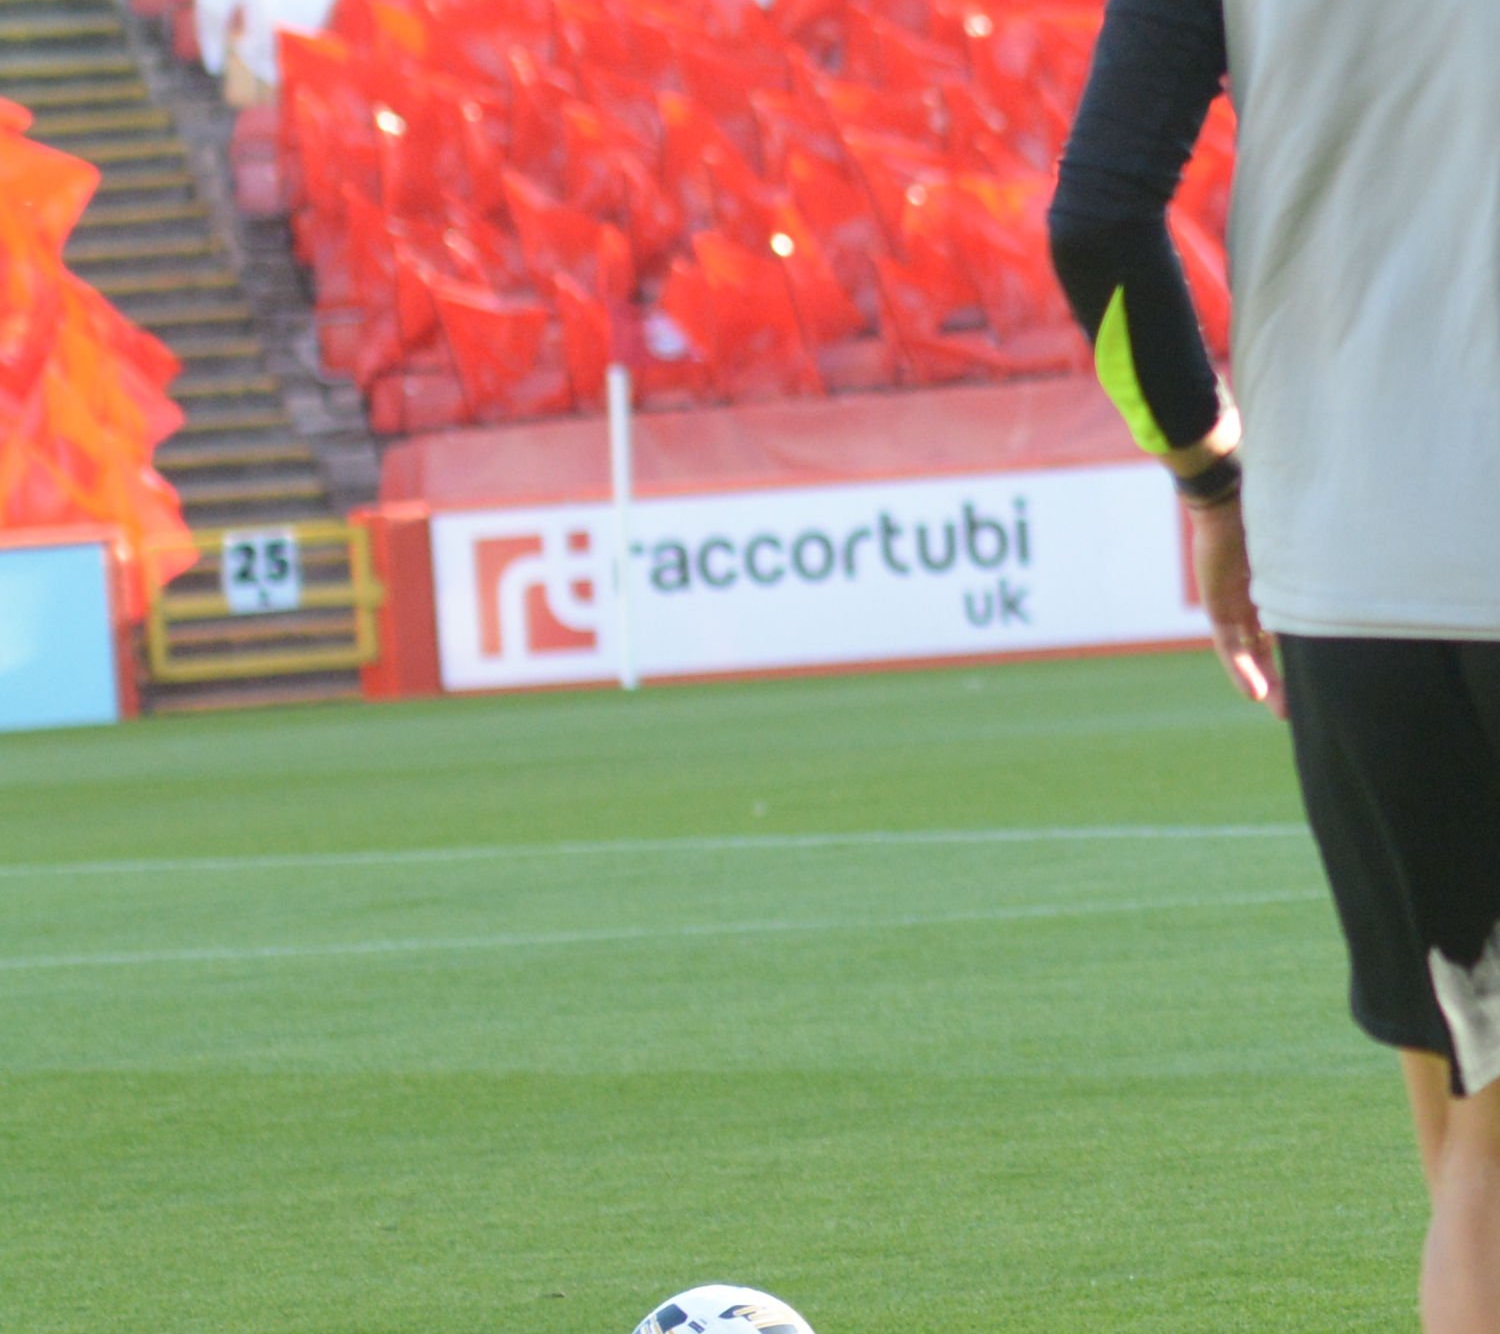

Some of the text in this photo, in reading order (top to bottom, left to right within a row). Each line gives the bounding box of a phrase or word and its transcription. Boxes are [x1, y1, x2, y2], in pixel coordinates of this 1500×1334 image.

[231, 539, 290, 584] 25
[613, 496, 1031, 591] accortubi
[964, 578, 1031, 627] uk
